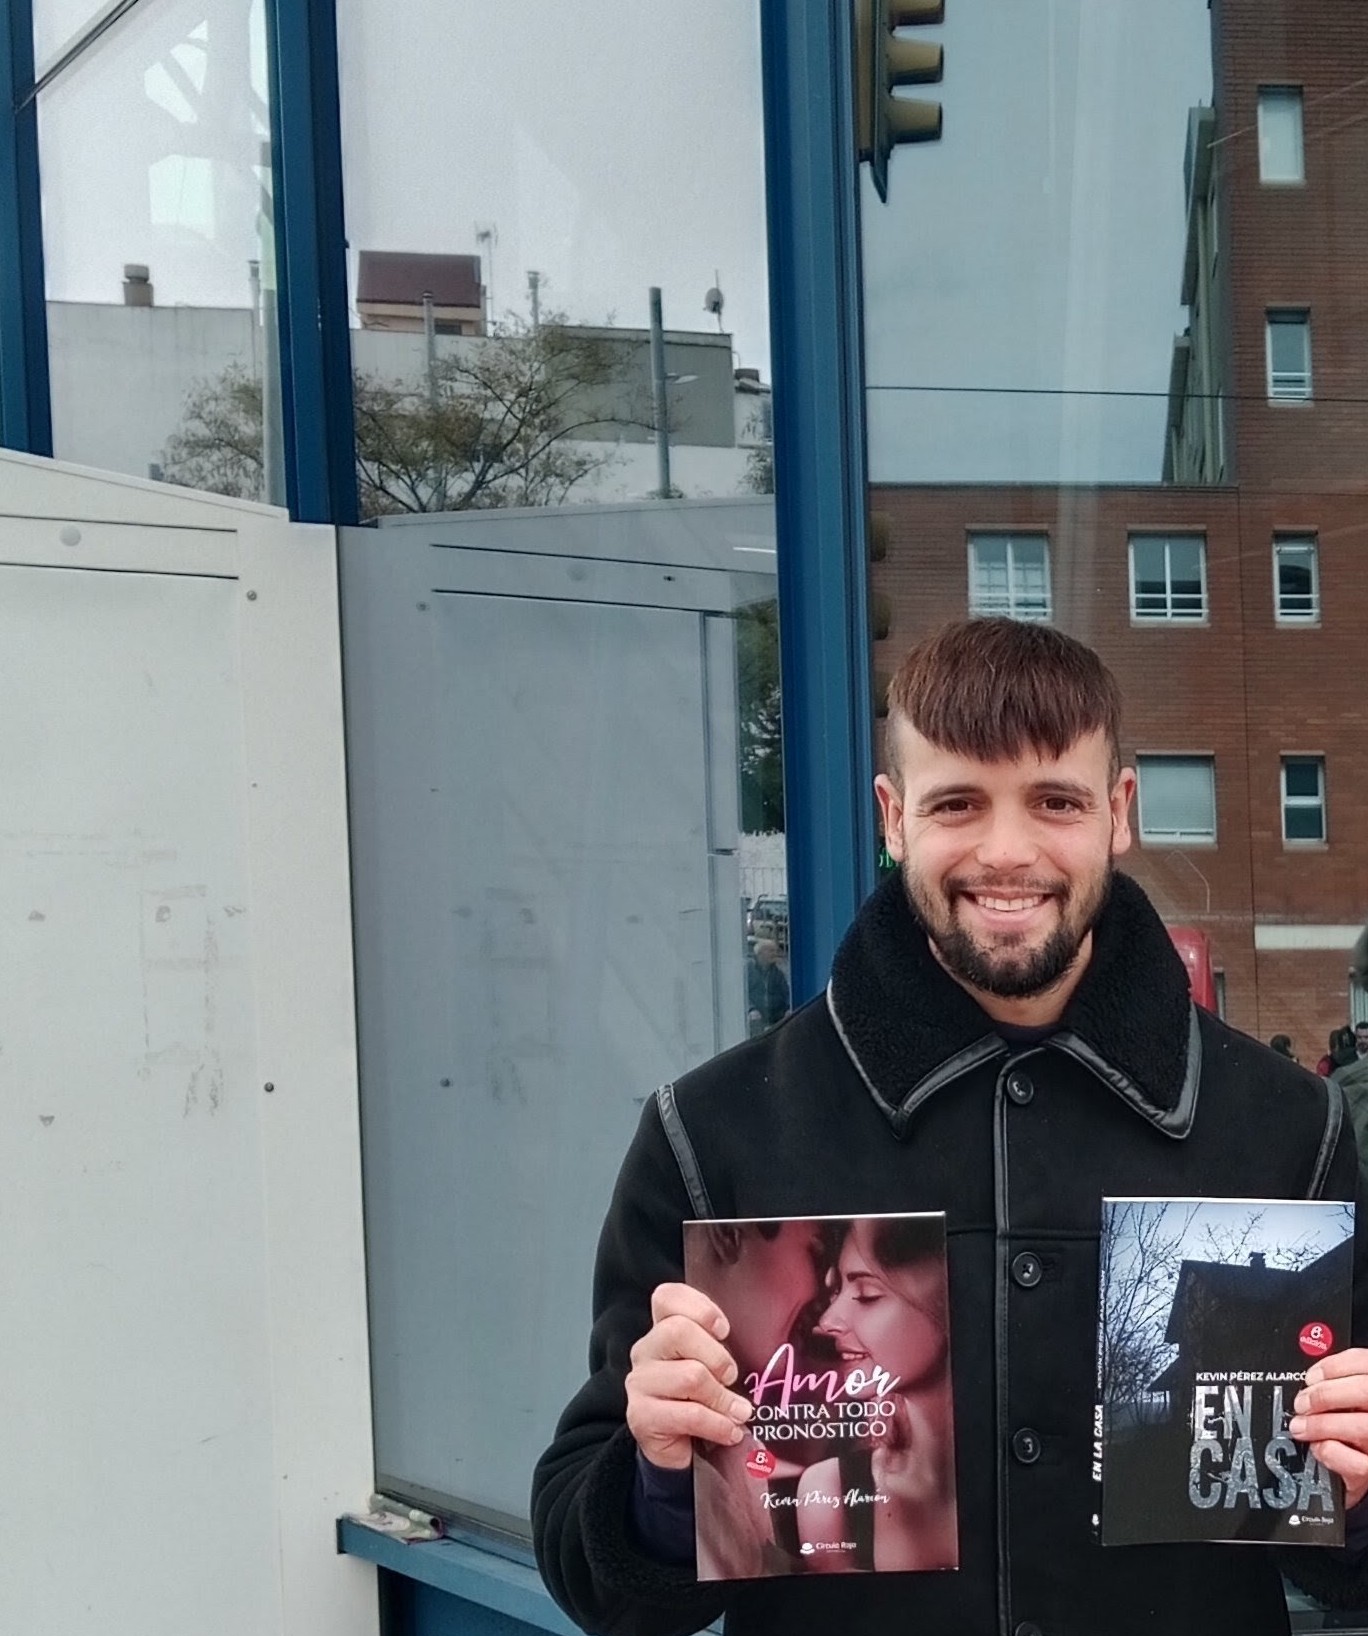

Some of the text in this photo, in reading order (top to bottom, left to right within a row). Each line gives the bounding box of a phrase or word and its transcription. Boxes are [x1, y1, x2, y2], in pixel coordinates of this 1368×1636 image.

[744, 1343, 901, 1415] Amor
[1196, 1370, 1308, 1381] KEVIN PÉREZ ALARCÓ
[834, 1401, 896, 1418] TODO
[1194, 1386, 1253, 1441] EN
[752, 1420, 887, 1441] PRONÓSTICO
[1093, 1405, 1104, 1481] EN LA CASA
[1189, 1436, 1334, 1511] CASA
[760, 1492, 800, 1509] Kevin
